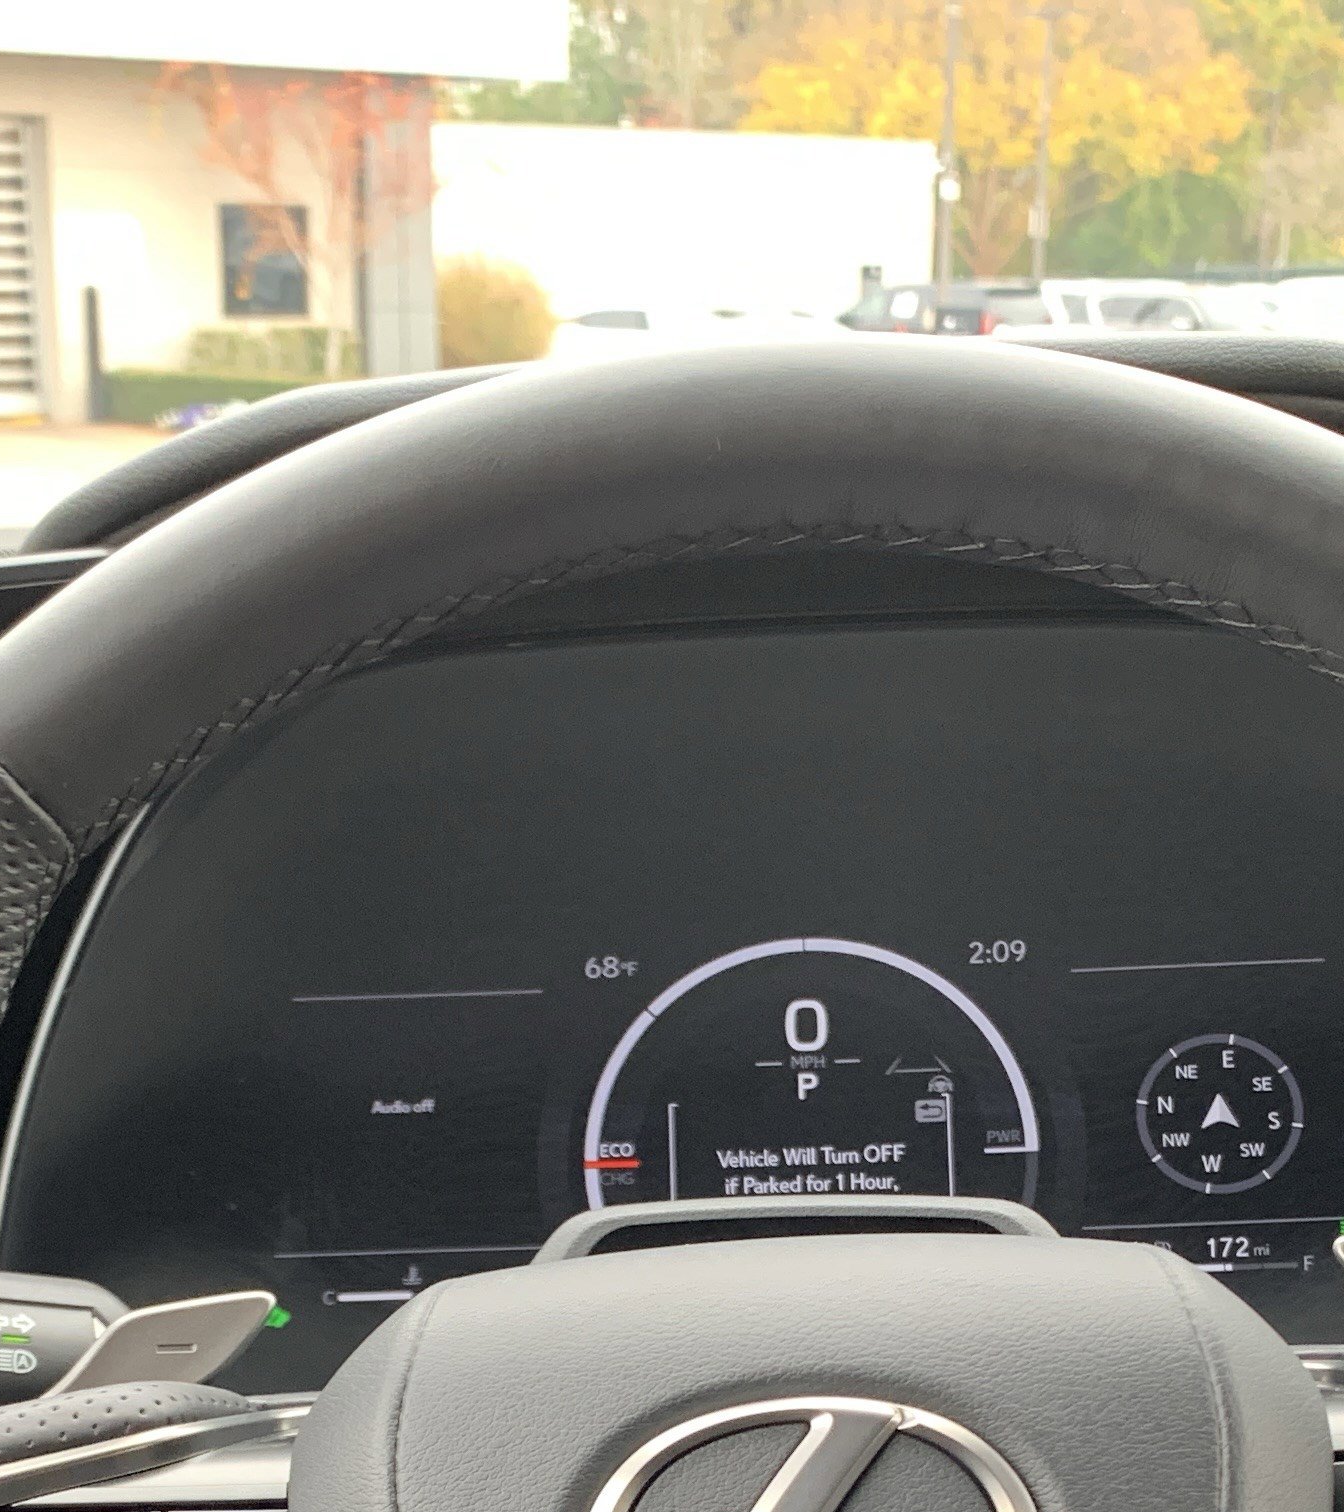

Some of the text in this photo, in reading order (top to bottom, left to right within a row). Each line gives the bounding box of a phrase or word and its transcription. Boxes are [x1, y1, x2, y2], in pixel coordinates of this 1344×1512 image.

[969, 940, 1026, 964] 2:09
[785, 999, 829, 1052] 0
[791, 1055, 826, 1069] MPH
[1222, 1050, 1235, 1069] E
[1175, 1064, 1199, 1080] NE
[797, 1073, 820, 1100] P
[1252, 1076, 1273, 1092] SE
[370, 1099, 435, 1114] Audio off
[1157, 1096, 1174, 1114] N
[1267, 1111, 1281, 1130] S
[986, 1130, 1021, 1143] PWR
[1162, 1132, 1191, 1148] NW
[599, 1142, 635, 1159] ECO
[716, 1144, 906, 1170] Vehicle Will Turn OFF
[1239, 1142, 1266, 1158] SW
[1201, 1154, 1222, 1173] W
[600, 1172, 636, 1187] CHG
[724, 1172, 900, 1196] if Parked for 1 Hour,
[1206, 1237, 1271, 1259] 172 mi
[1303, 1254, 1316, 1271] F
